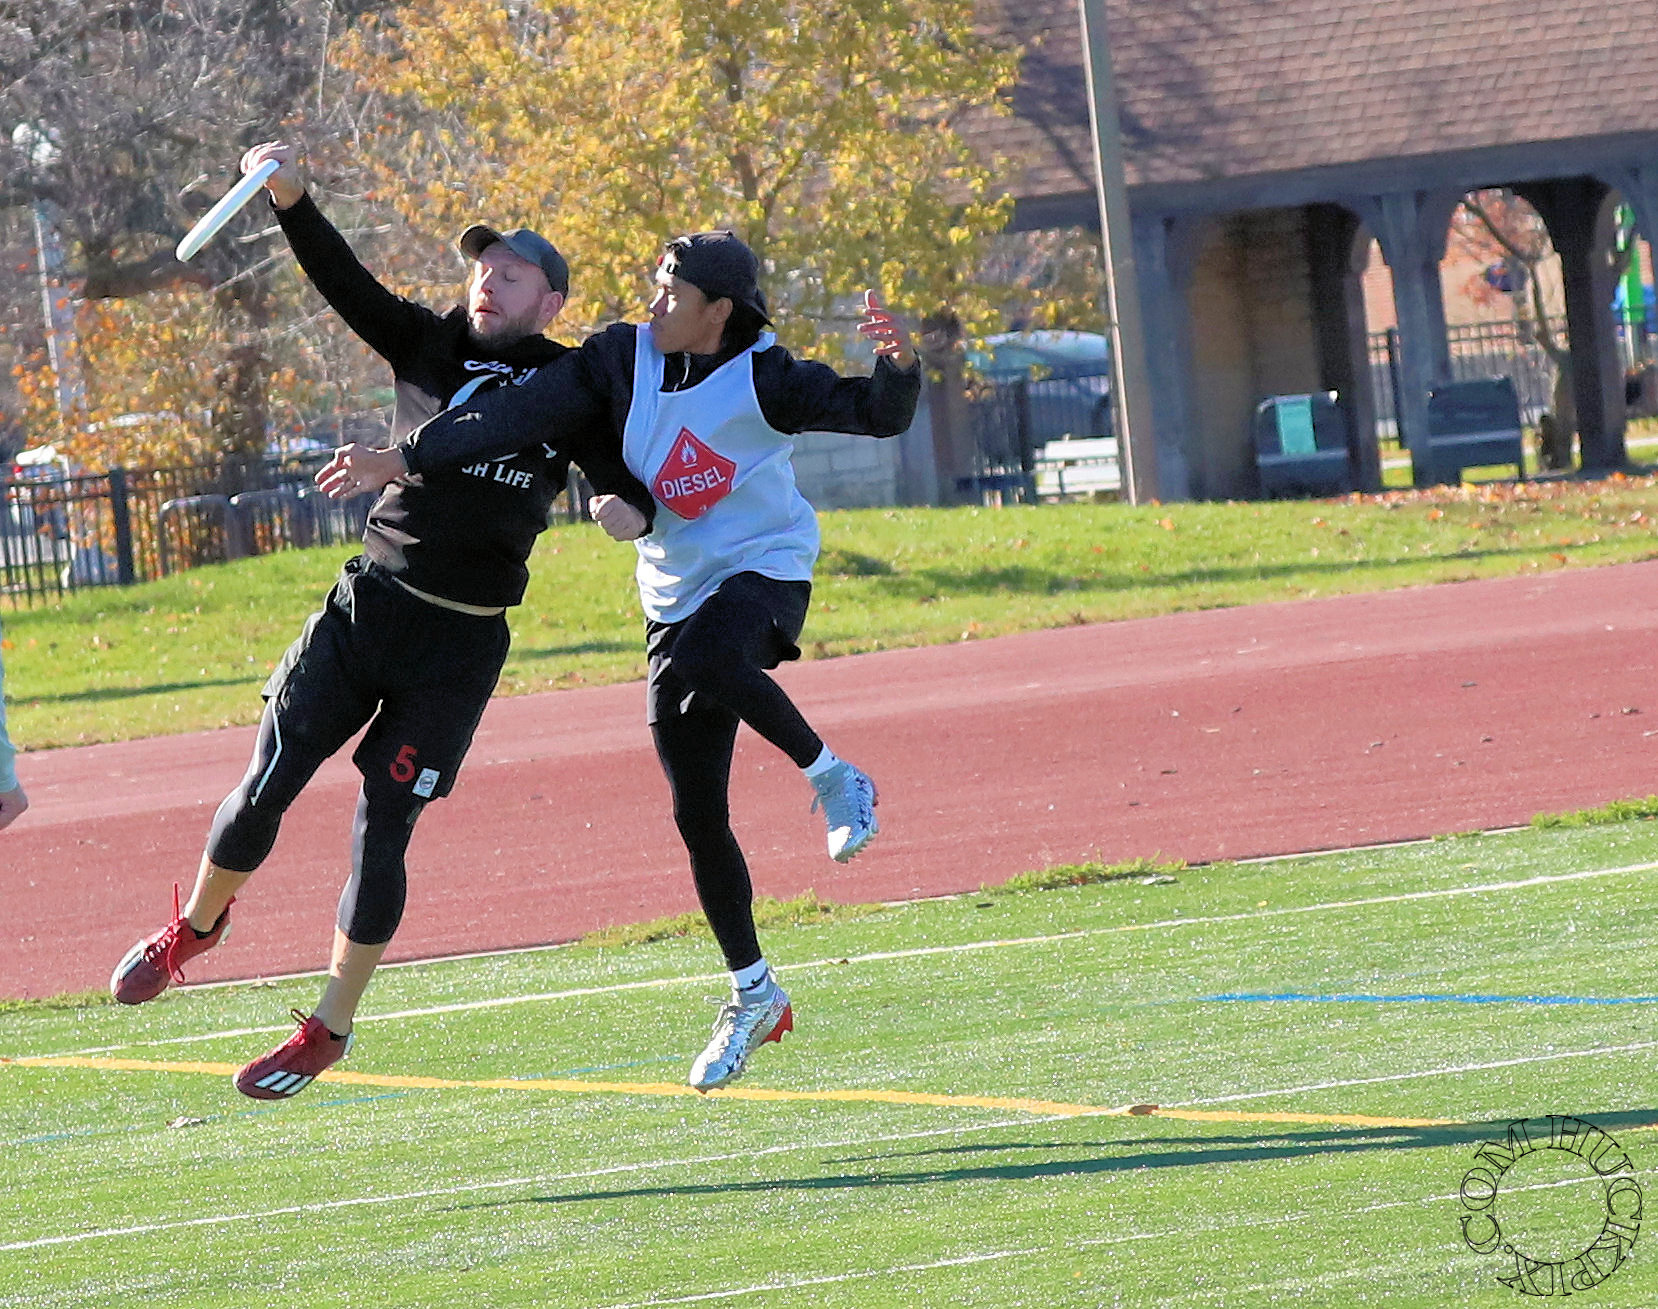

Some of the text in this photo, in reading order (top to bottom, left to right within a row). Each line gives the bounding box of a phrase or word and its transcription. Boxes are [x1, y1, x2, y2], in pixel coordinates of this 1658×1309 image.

[494, 463, 534, 489] LIFE
[661, 466, 727, 499] DIESEL
[389, 744, 417, 783] 5
